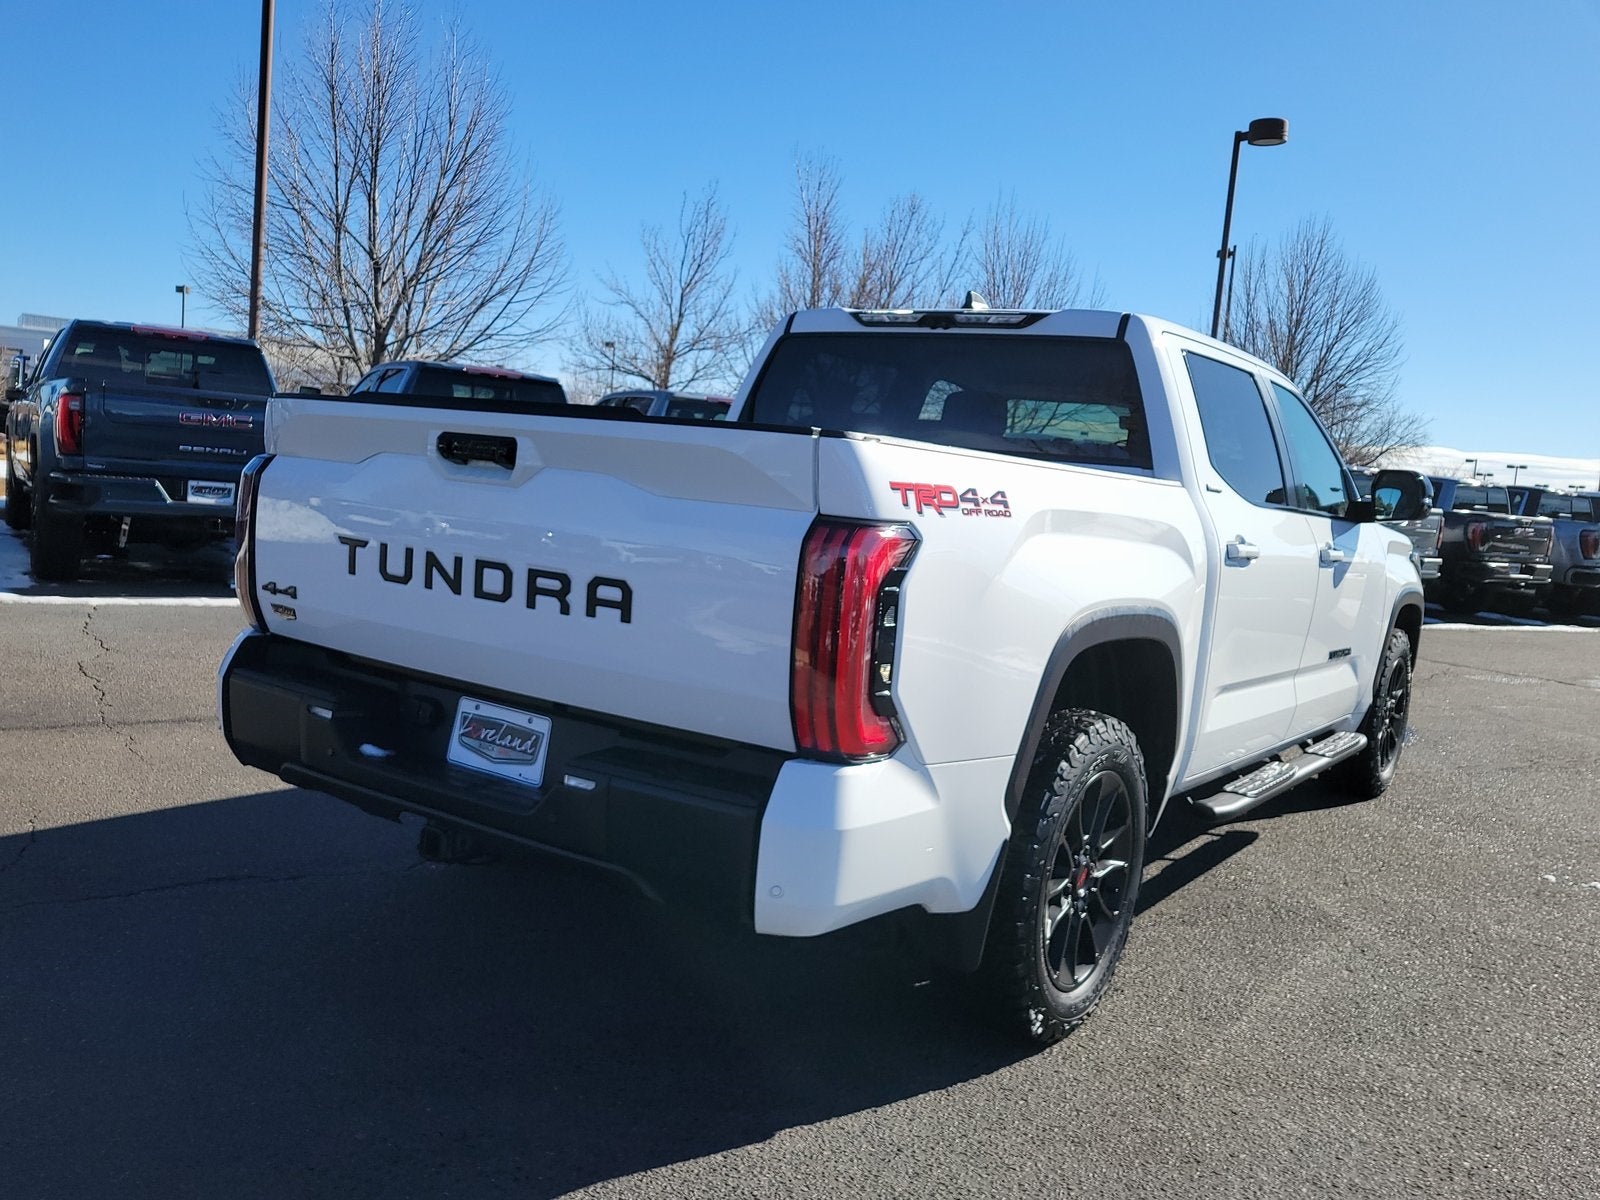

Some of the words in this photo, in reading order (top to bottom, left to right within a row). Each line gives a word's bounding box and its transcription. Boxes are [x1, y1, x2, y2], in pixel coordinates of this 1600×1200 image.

[179, 413, 253, 428] GMC
[179, 445, 247, 455] DENALI
[889, 481, 959, 516] TRD
[962, 508, 982, 517] OFF
[984, 509, 1012, 518] ROAD
[338, 536, 633, 624] TUNDRA
